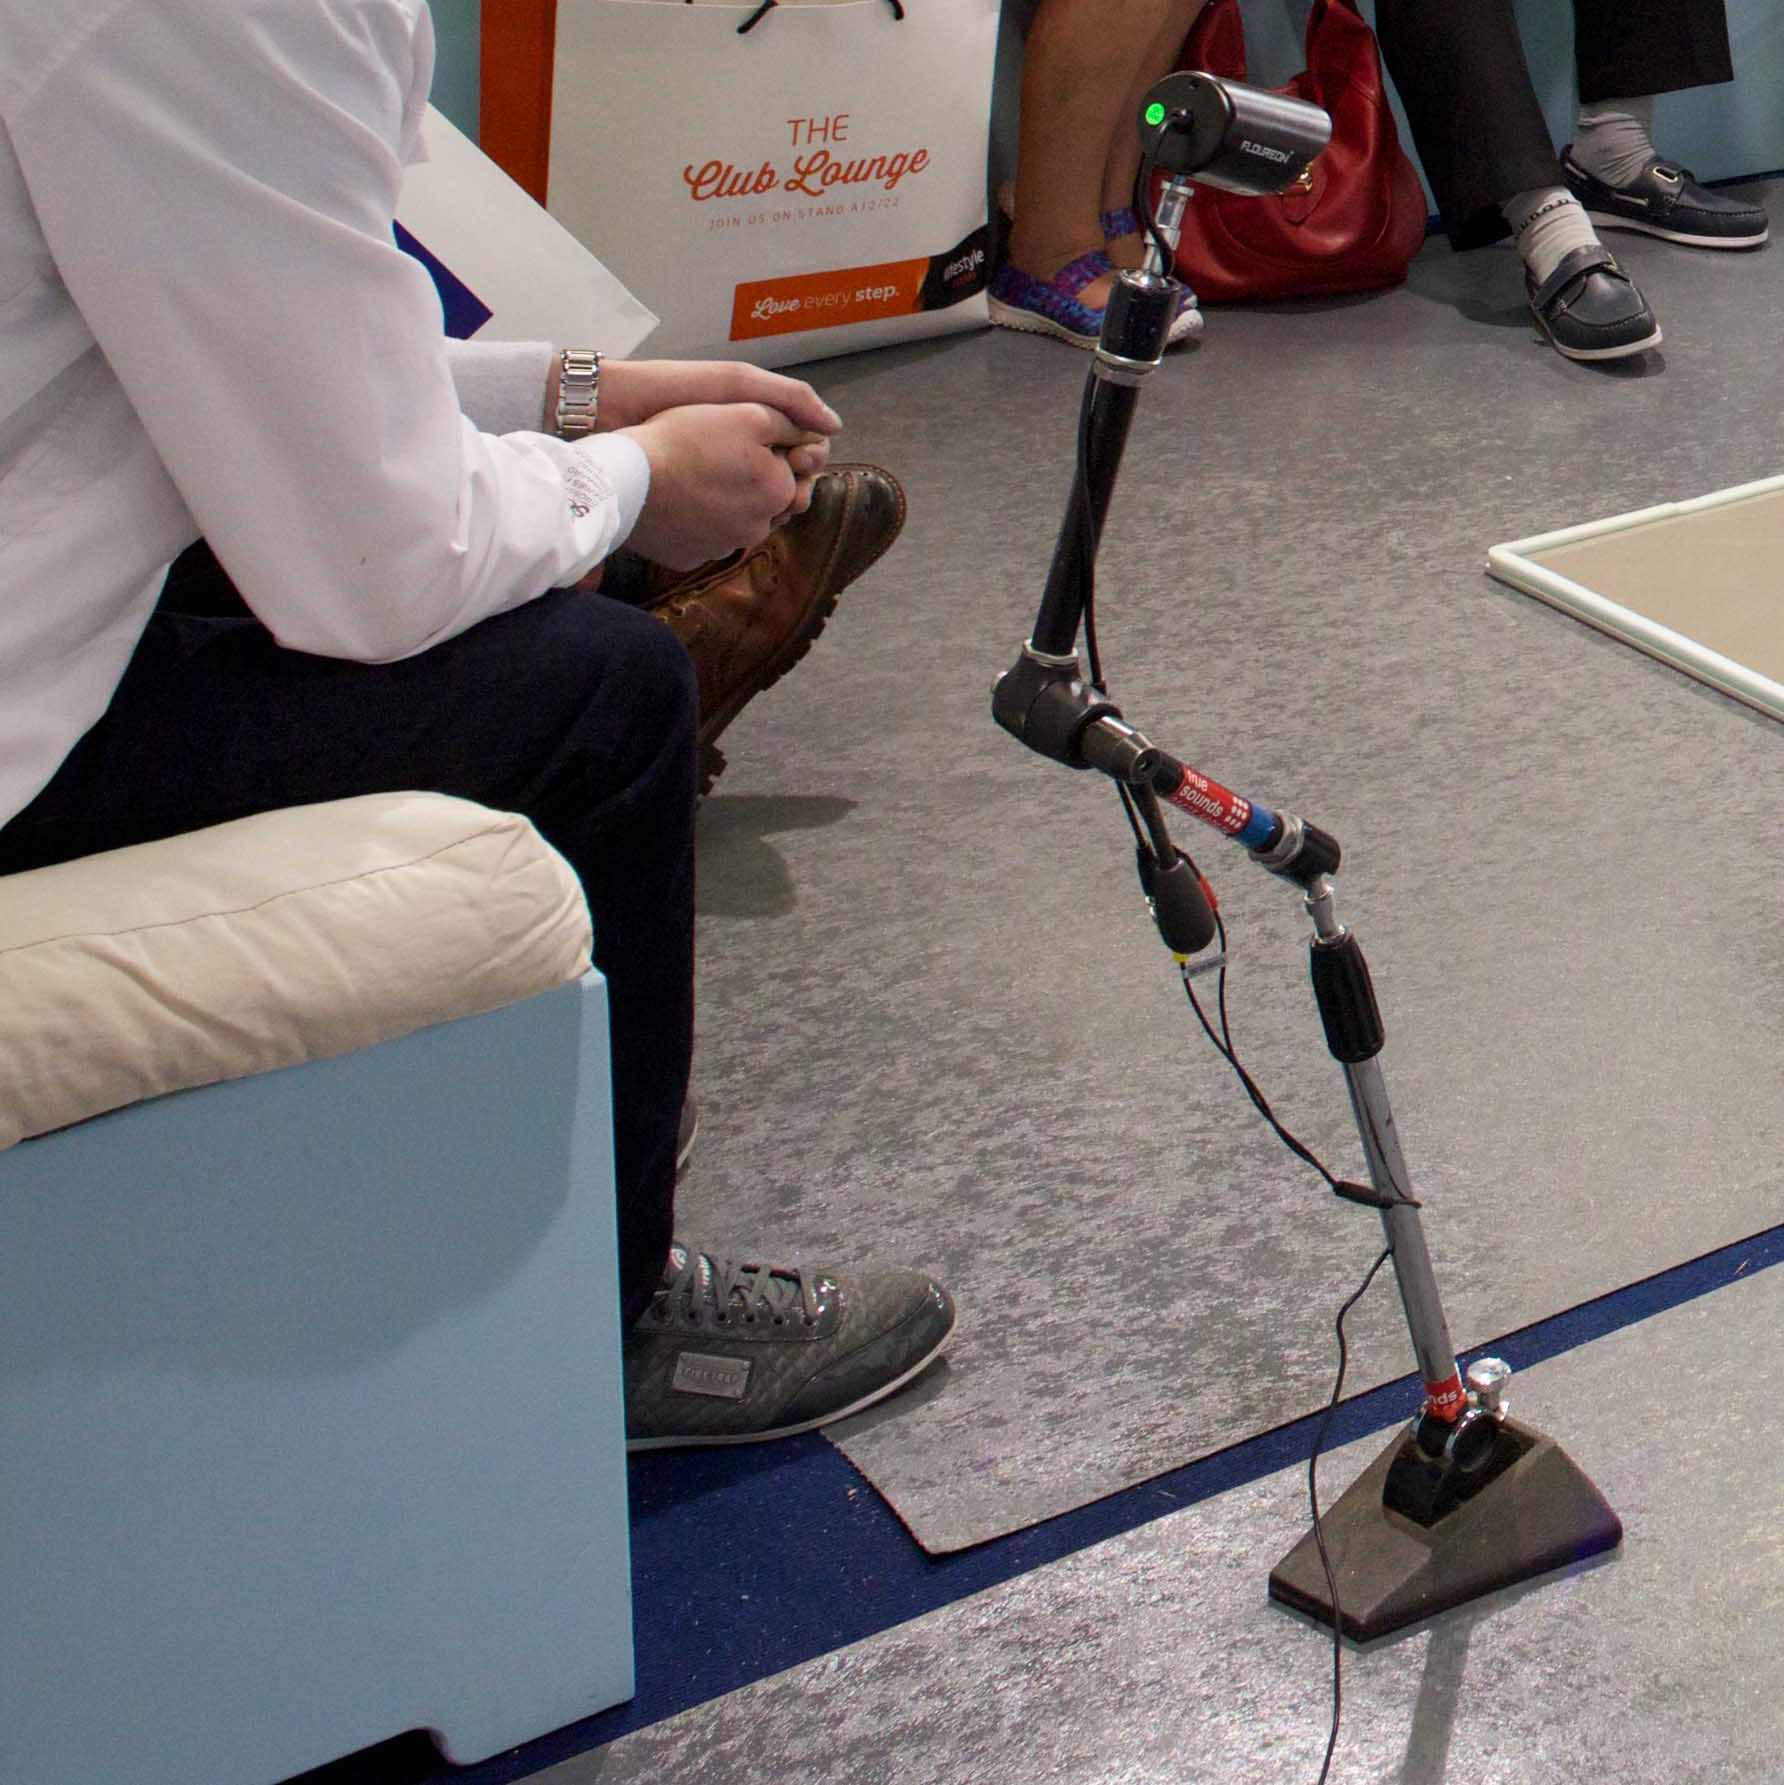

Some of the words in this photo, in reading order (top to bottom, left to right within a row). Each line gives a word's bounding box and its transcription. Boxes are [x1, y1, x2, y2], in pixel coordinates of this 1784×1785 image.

[786, 114, 850, 147] THE
[683, 159, 780, 202] Club
[783, 148, 931, 198] Lounge
[709, 216, 741, 231] JOIN
[748, 216, 768, 226] US
[771, 211, 792, 224] ON
[797, 205, 845, 220] STAND
[850, 197, 901, 214] A12/22
[750, 296, 801, 320] Love
[803, 289, 852, 309] every
[855, 283, 901, 304] step.
[1179, 785, 1225, 818] sounds
[1427, 1390, 1459, 1406] nds
